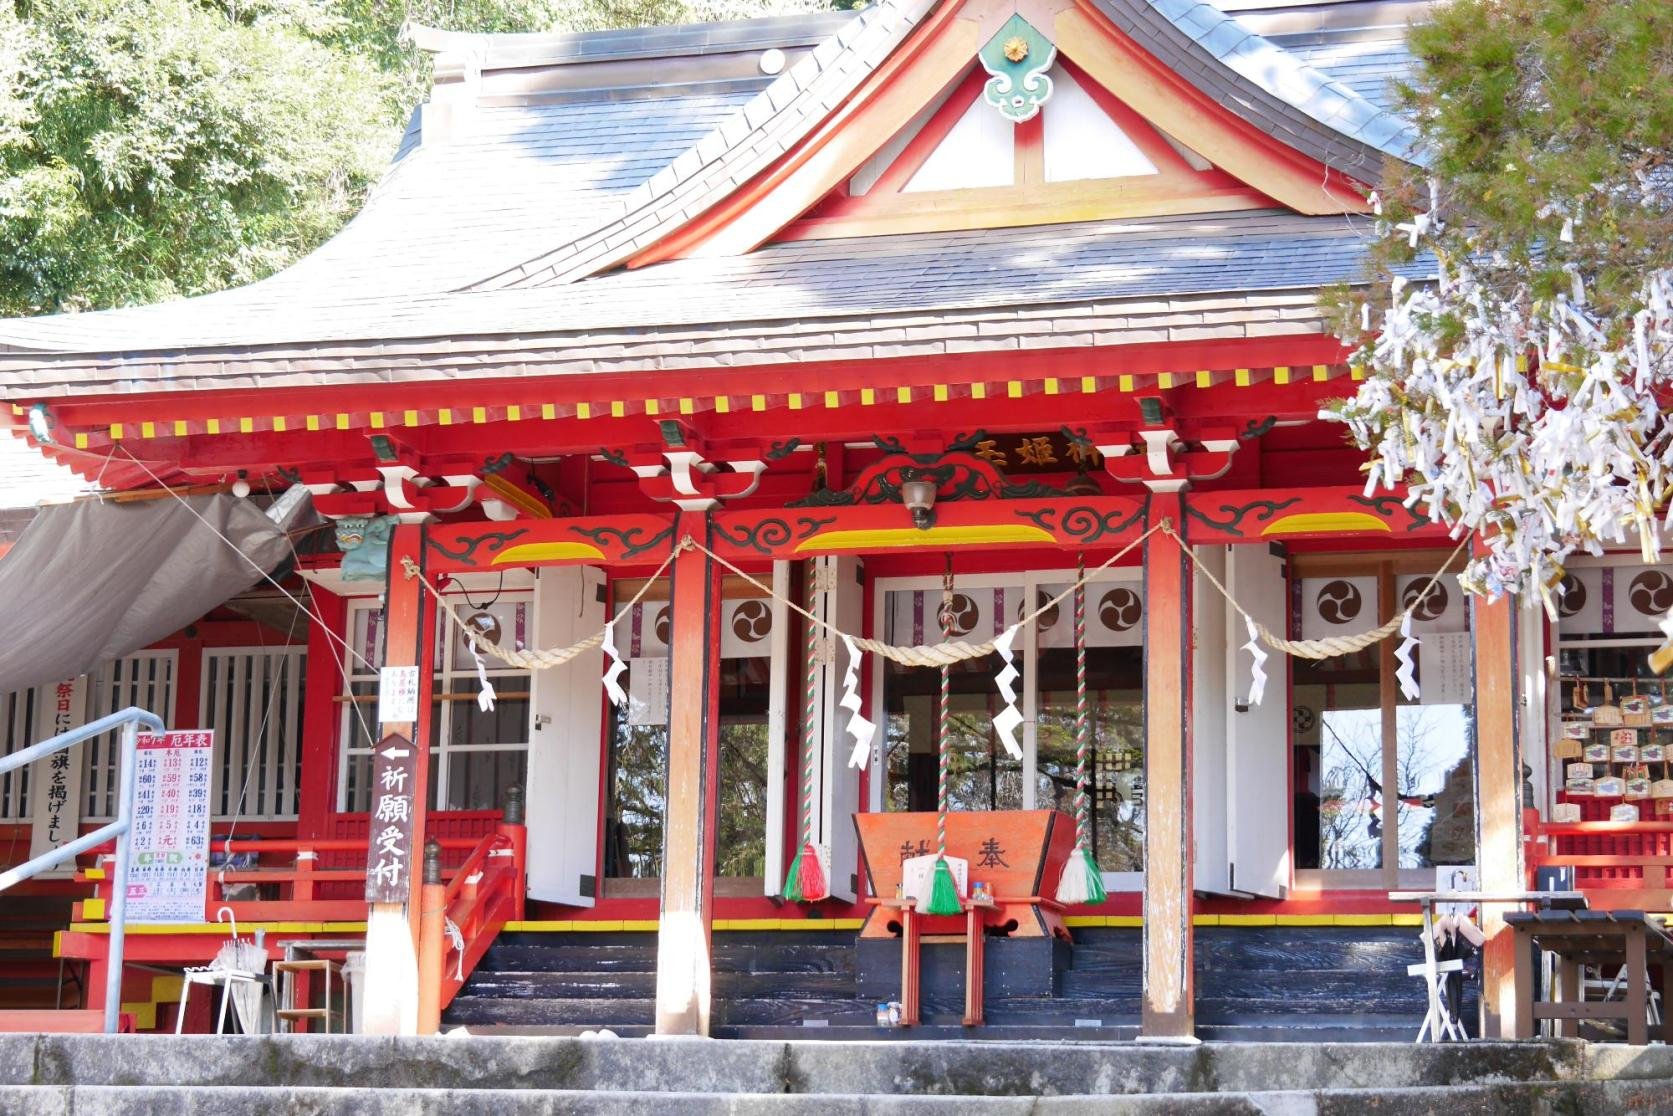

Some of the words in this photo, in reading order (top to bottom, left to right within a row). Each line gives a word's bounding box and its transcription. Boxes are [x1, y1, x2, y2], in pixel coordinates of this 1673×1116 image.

[48, 678, 75, 870] 祭日には旗を掲げまし
[171, 733, 208, 746] 厄年表
[375, 766, 409, 887] 祈願受付
[976, 837, 1009, 869] 奉
